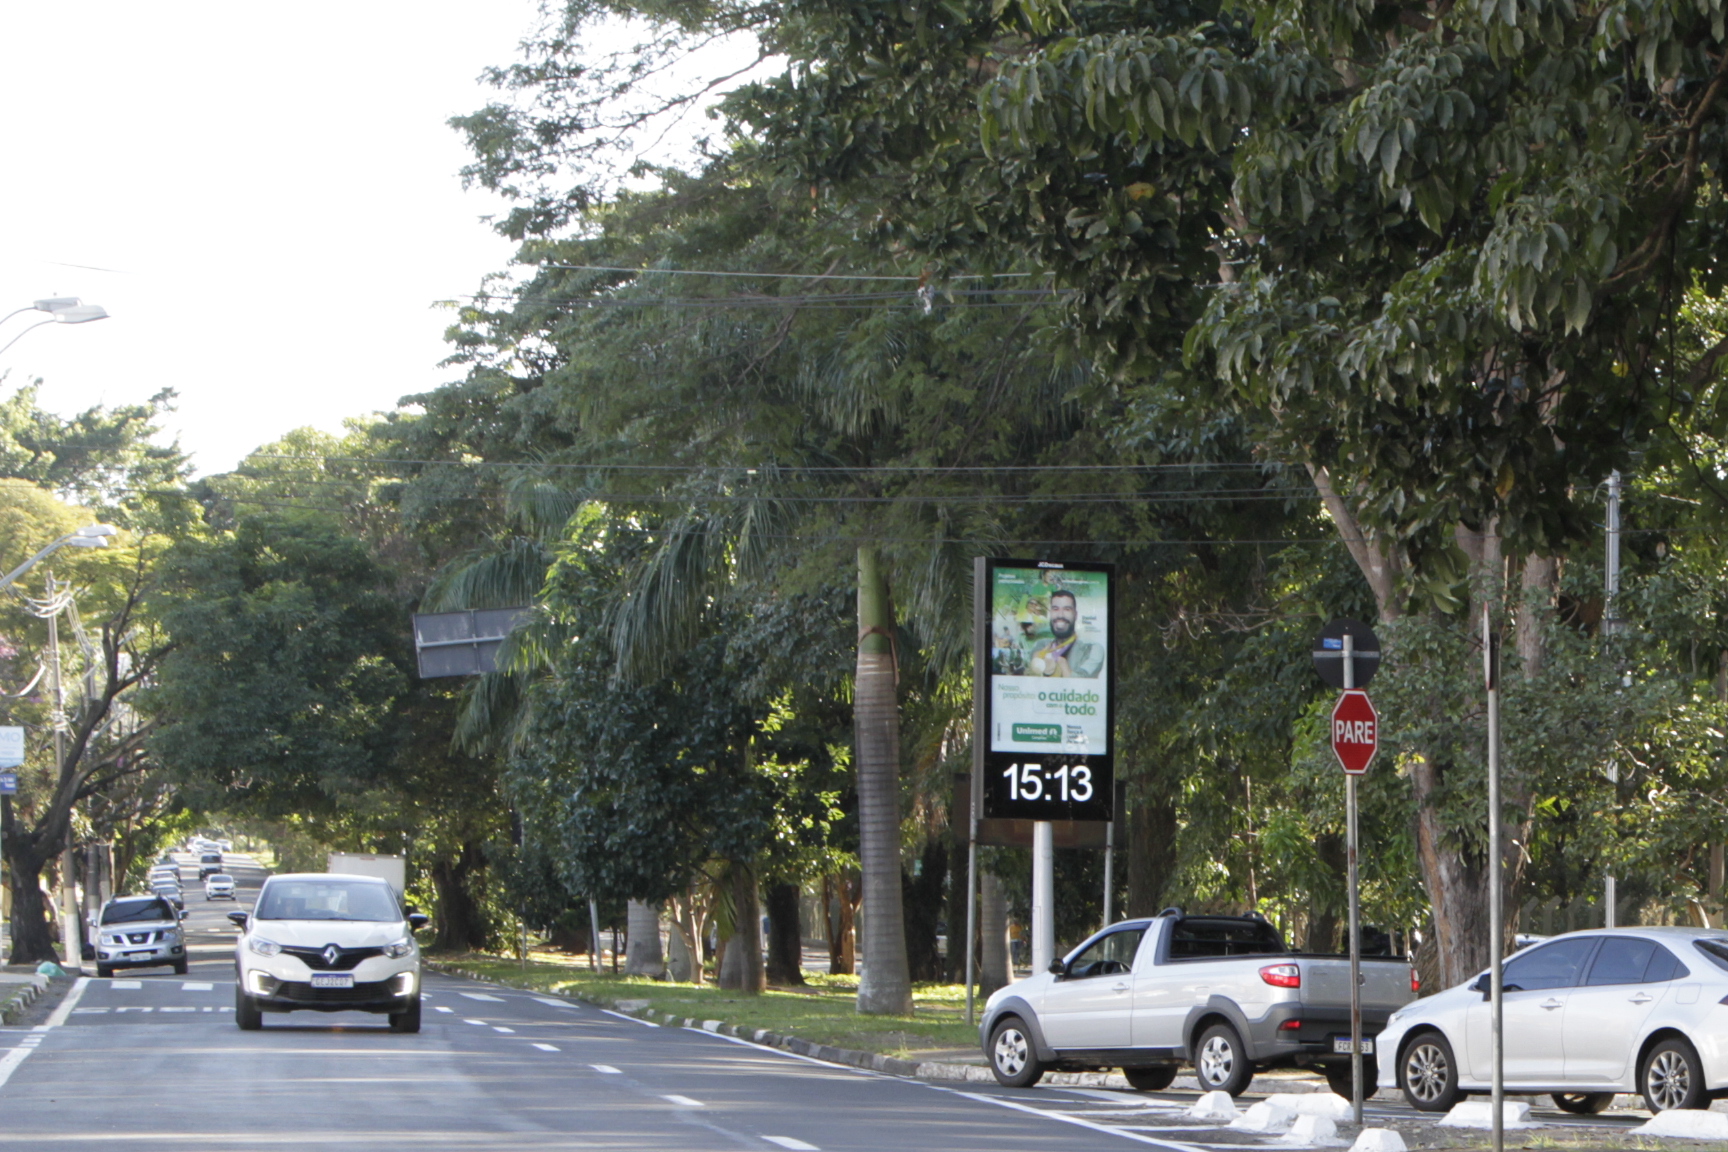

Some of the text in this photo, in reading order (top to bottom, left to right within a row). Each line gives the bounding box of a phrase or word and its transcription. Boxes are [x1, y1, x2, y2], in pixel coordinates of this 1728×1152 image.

[998, 683, 1019, 692] Nosso
[1038, 691, 1047, 701] o
[1048, 689, 1099, 703] cuidado
[1016, 726, 1048, 735] Unimed
[1335, 719, 1374, 745] PARE
[1002, 762, 1094, 803] 15:13
